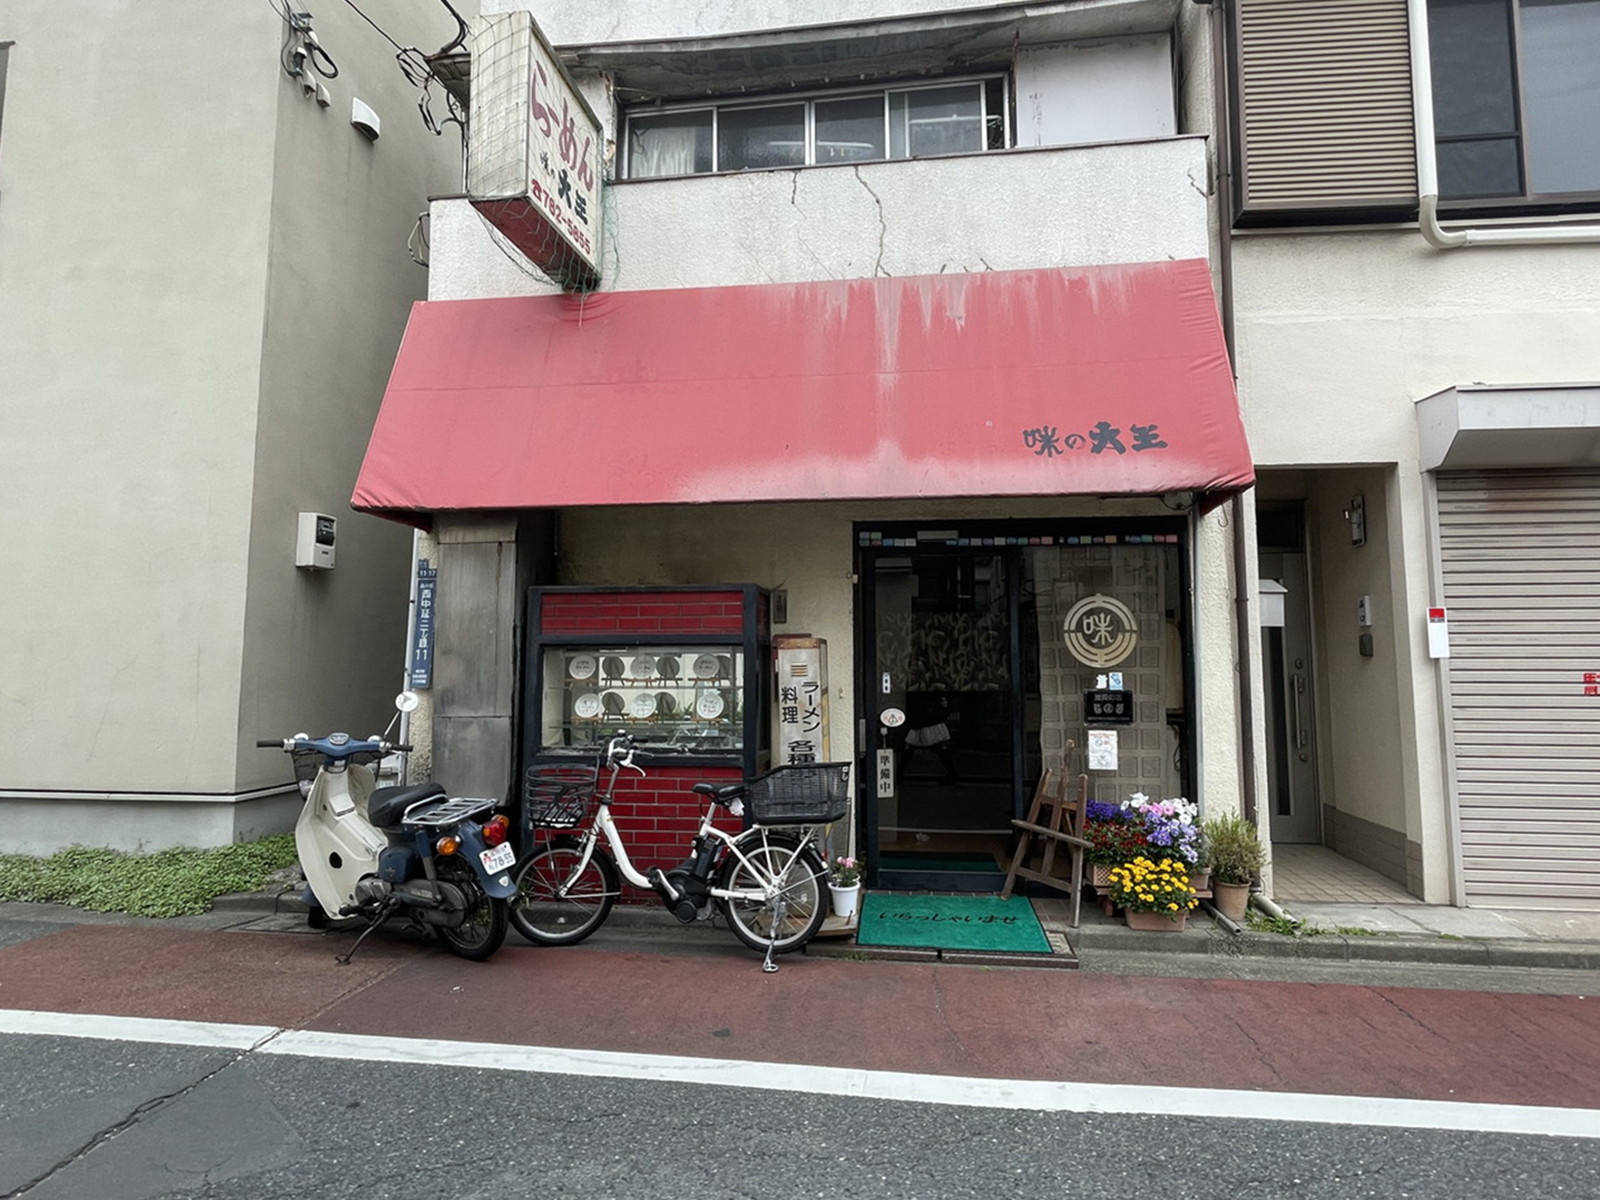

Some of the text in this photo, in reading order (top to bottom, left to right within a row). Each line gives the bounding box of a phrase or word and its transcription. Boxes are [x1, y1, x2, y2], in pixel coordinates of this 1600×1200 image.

[531, 60, 593, 191] らーめん
[1022, 421, 1168, 458] 味の大王
[1082, 612, 1114, 645] 味
[781, 686, 799, 724] 料理
[802, 681, 820, 733] ラーメン
[879, 912, 1017, 925] いらっしゃいませ
